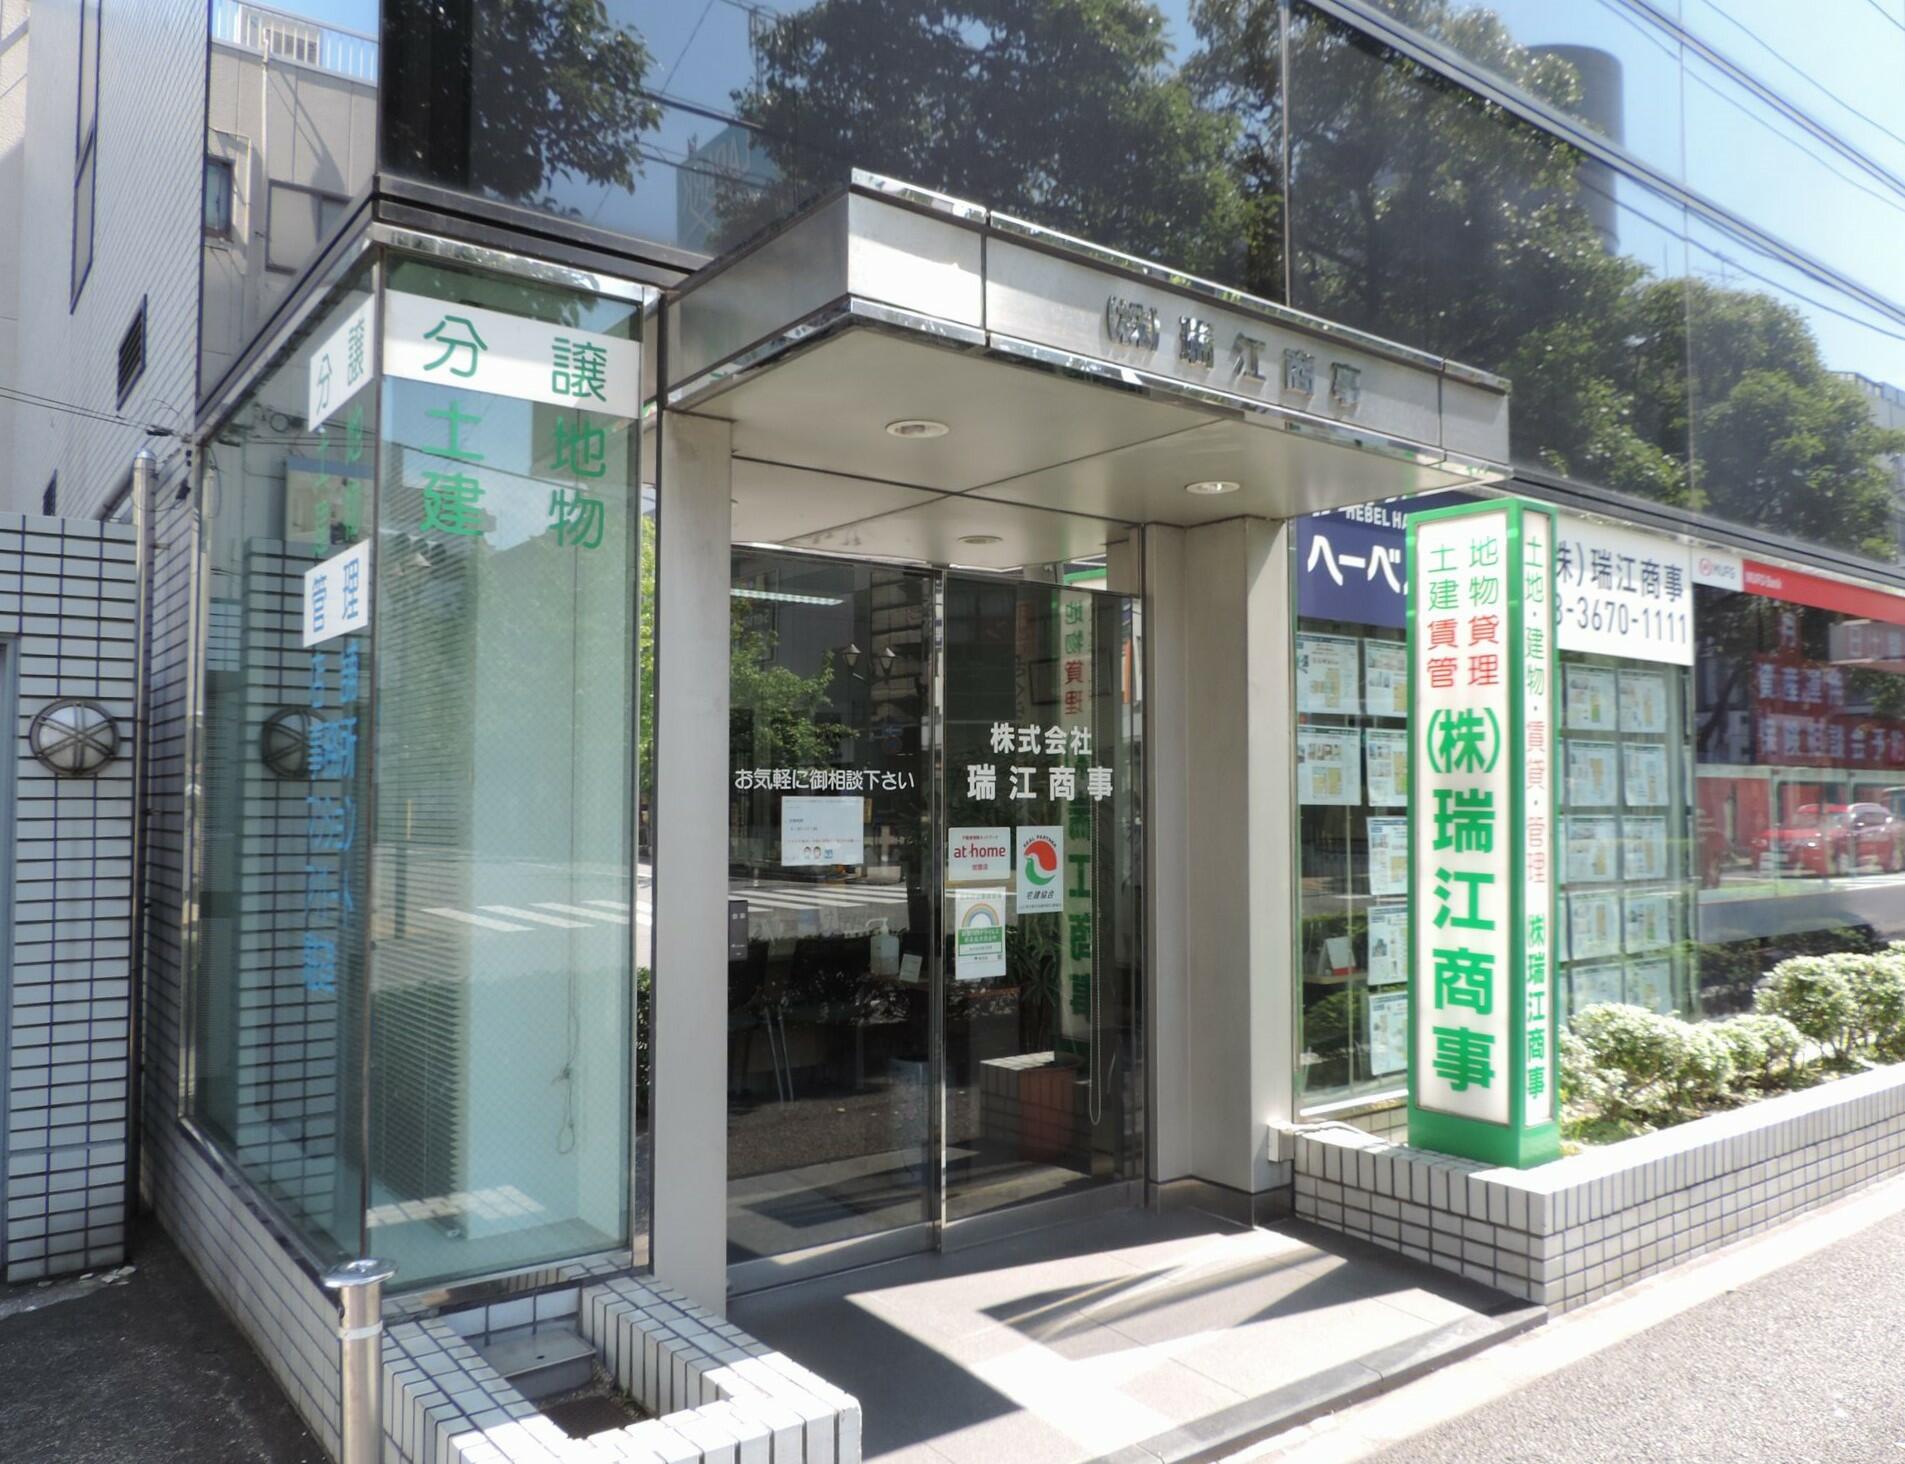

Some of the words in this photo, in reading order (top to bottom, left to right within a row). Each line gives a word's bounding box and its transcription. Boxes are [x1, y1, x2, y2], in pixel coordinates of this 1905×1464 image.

[422, 314, 608, 403] 分譲
[421, 398, 607, 479] 土地
[419, 471, 607, 551] 建物
[1307, 534, 1408, 596] ヘーベ
[990, 722, 1092, 756] 株式会社
[734, 768, 915, 791] お気軽に御相談下さい
[967, 763, 1114, 802] 瑞江商事
[970, 843, 1006, 858] home
[1426, 706, 1501, 1093] (株)瑞江商事
